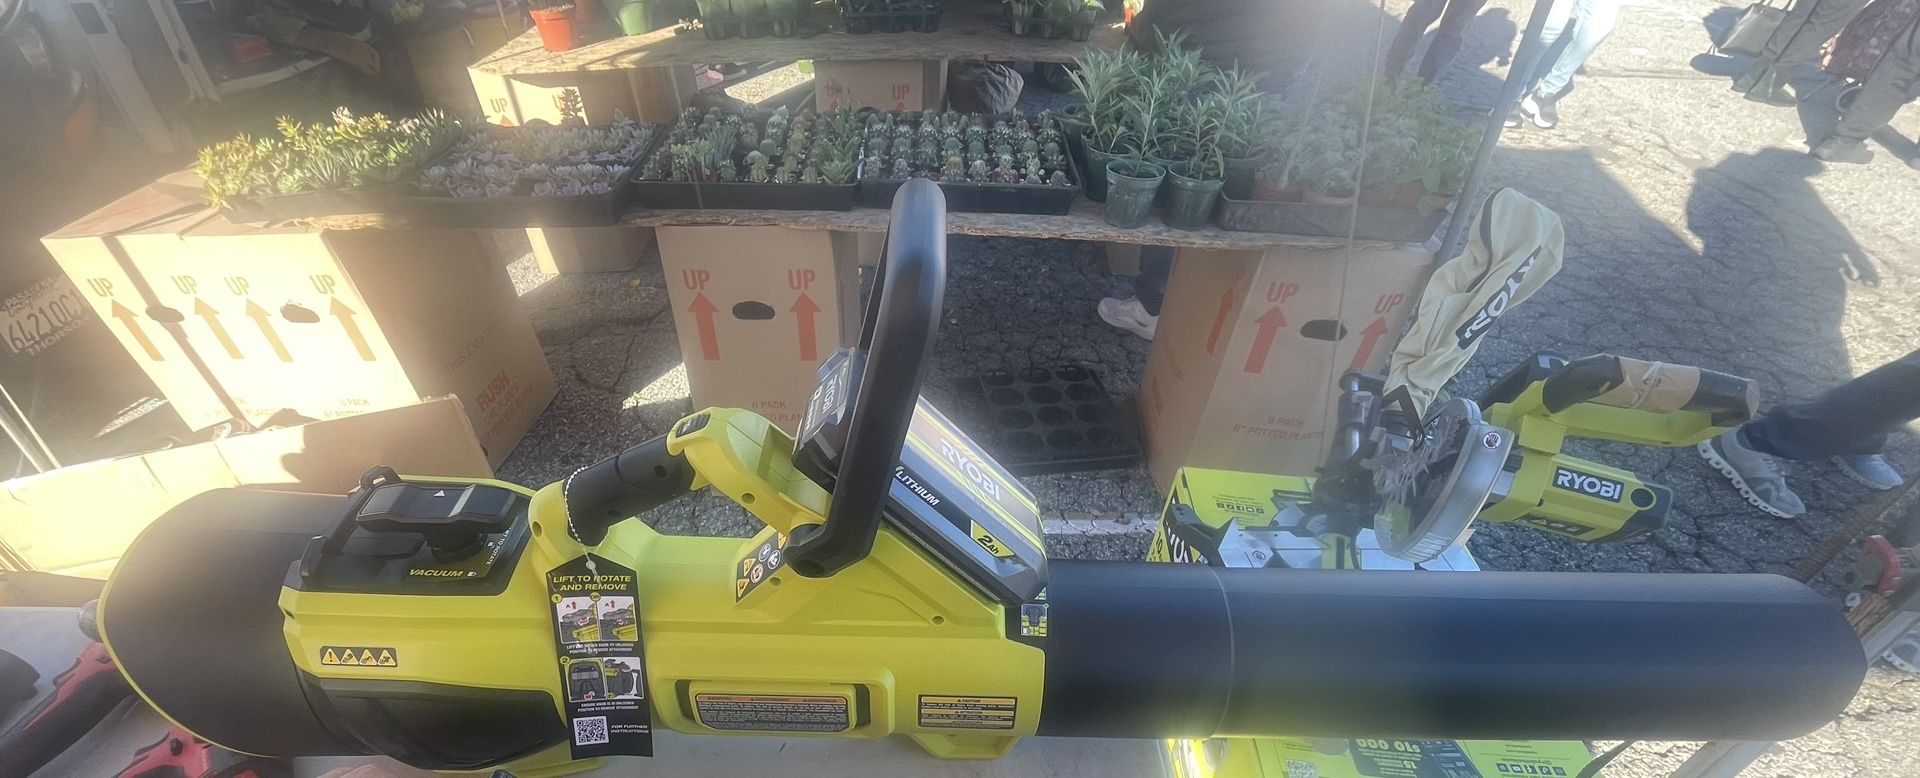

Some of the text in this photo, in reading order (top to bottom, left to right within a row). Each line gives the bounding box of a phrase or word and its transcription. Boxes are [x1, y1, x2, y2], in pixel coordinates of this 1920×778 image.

[892, 84, 909, 100] UP
[490, 97, 508, 113] UP
[86, 278, 114, 297] UP
[170, 275, 198, 295] UP
[224, 276, 250, 296] UP
[309, 274, 336, 295] UP
[682, 269, 711, 290] UP
[787, 269, 816, 290] UP
[1266, 281, 1299, 303] UP
[1374, 293, 1404, 314] UP
[941, 438, 1000, 501] RYOBI
[895, 470, 940, 506] LITHIUM
[1556, 469, 1622, 500] RYOBI
[977, 534, 1000, 555] 2Ah
[409, 568, 464, 578] VACUUM
[553, 575, 575, 583] LIFT
[560, 583, 627, 591] AND REMOVE
[1402, 760, 1418, 770] 15
